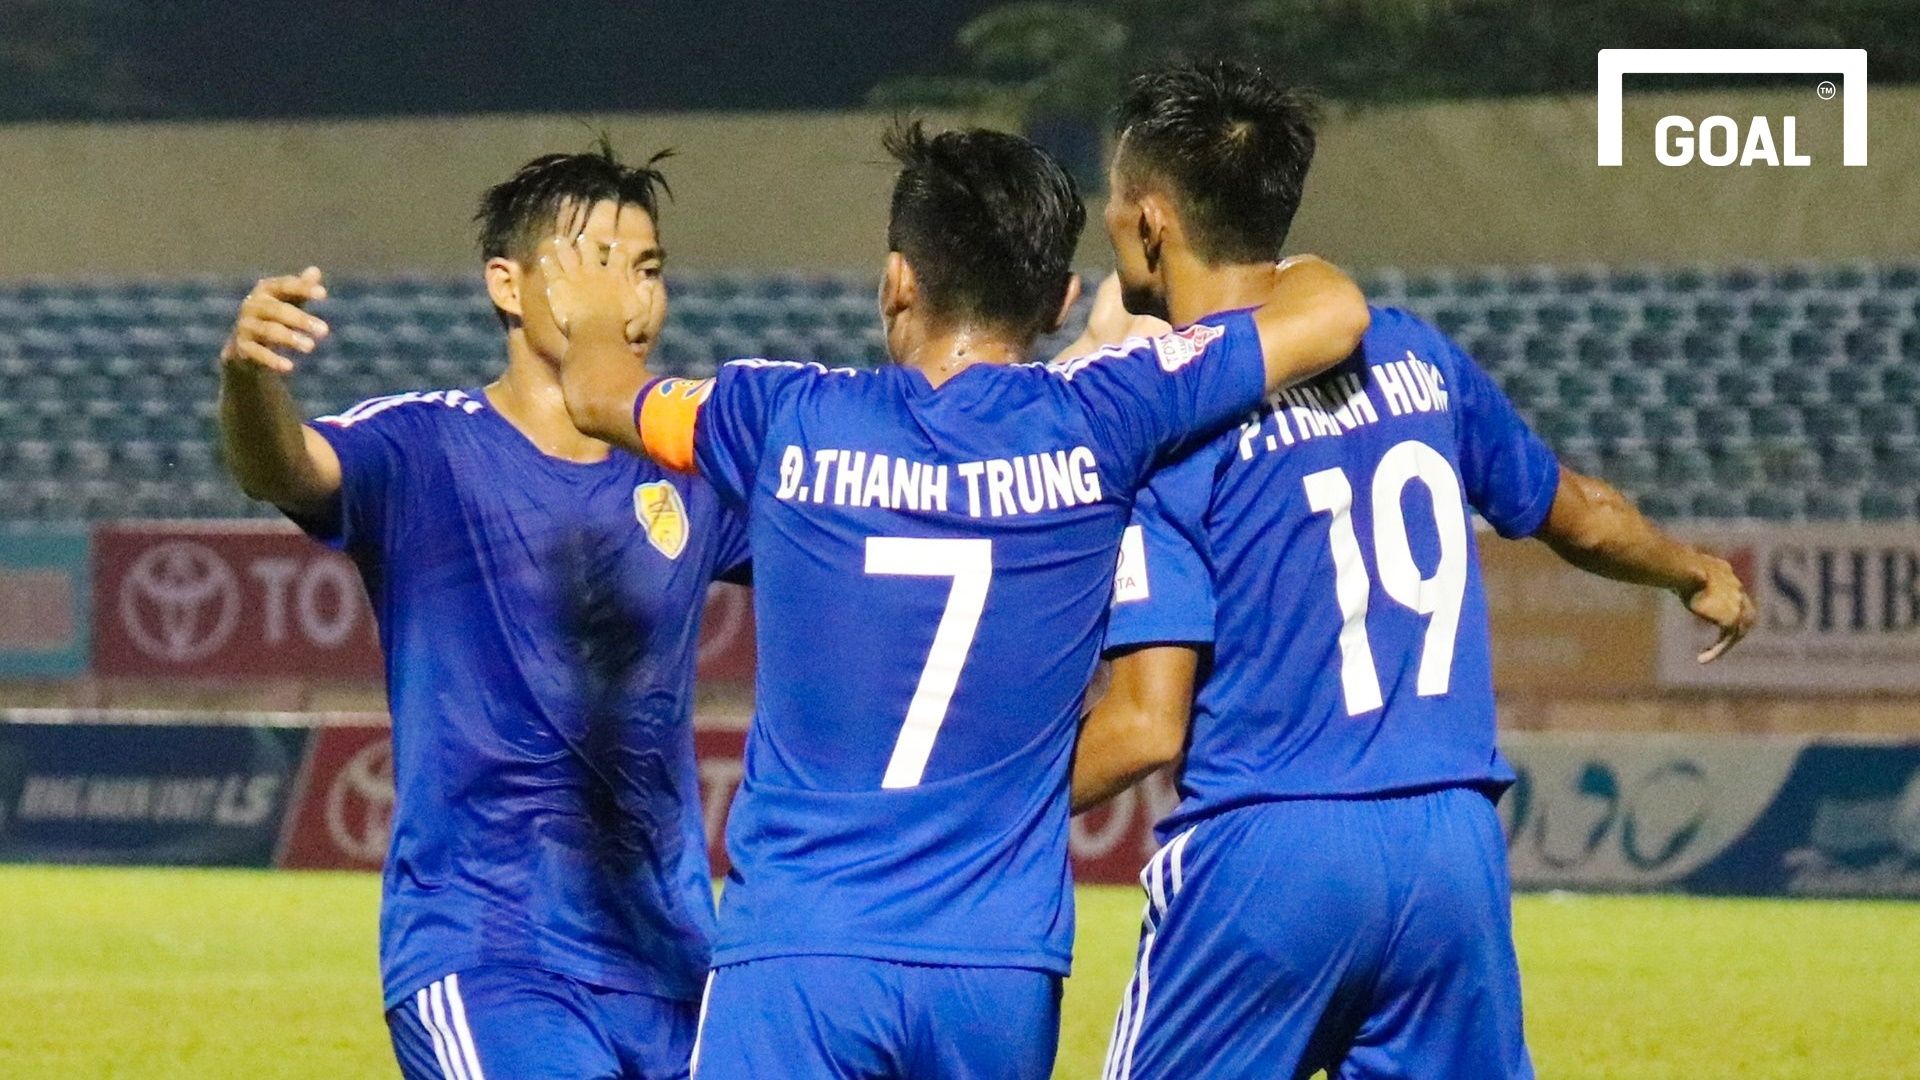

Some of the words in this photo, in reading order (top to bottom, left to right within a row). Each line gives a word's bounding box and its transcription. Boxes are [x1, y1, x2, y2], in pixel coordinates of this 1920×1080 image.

[776, 445, 948, 512] Đ.THANH
[958, 446, 1102, 518] TRUNG
[1303, 440, 1468, 716] 19
[864, 536, 993, 789] 7
